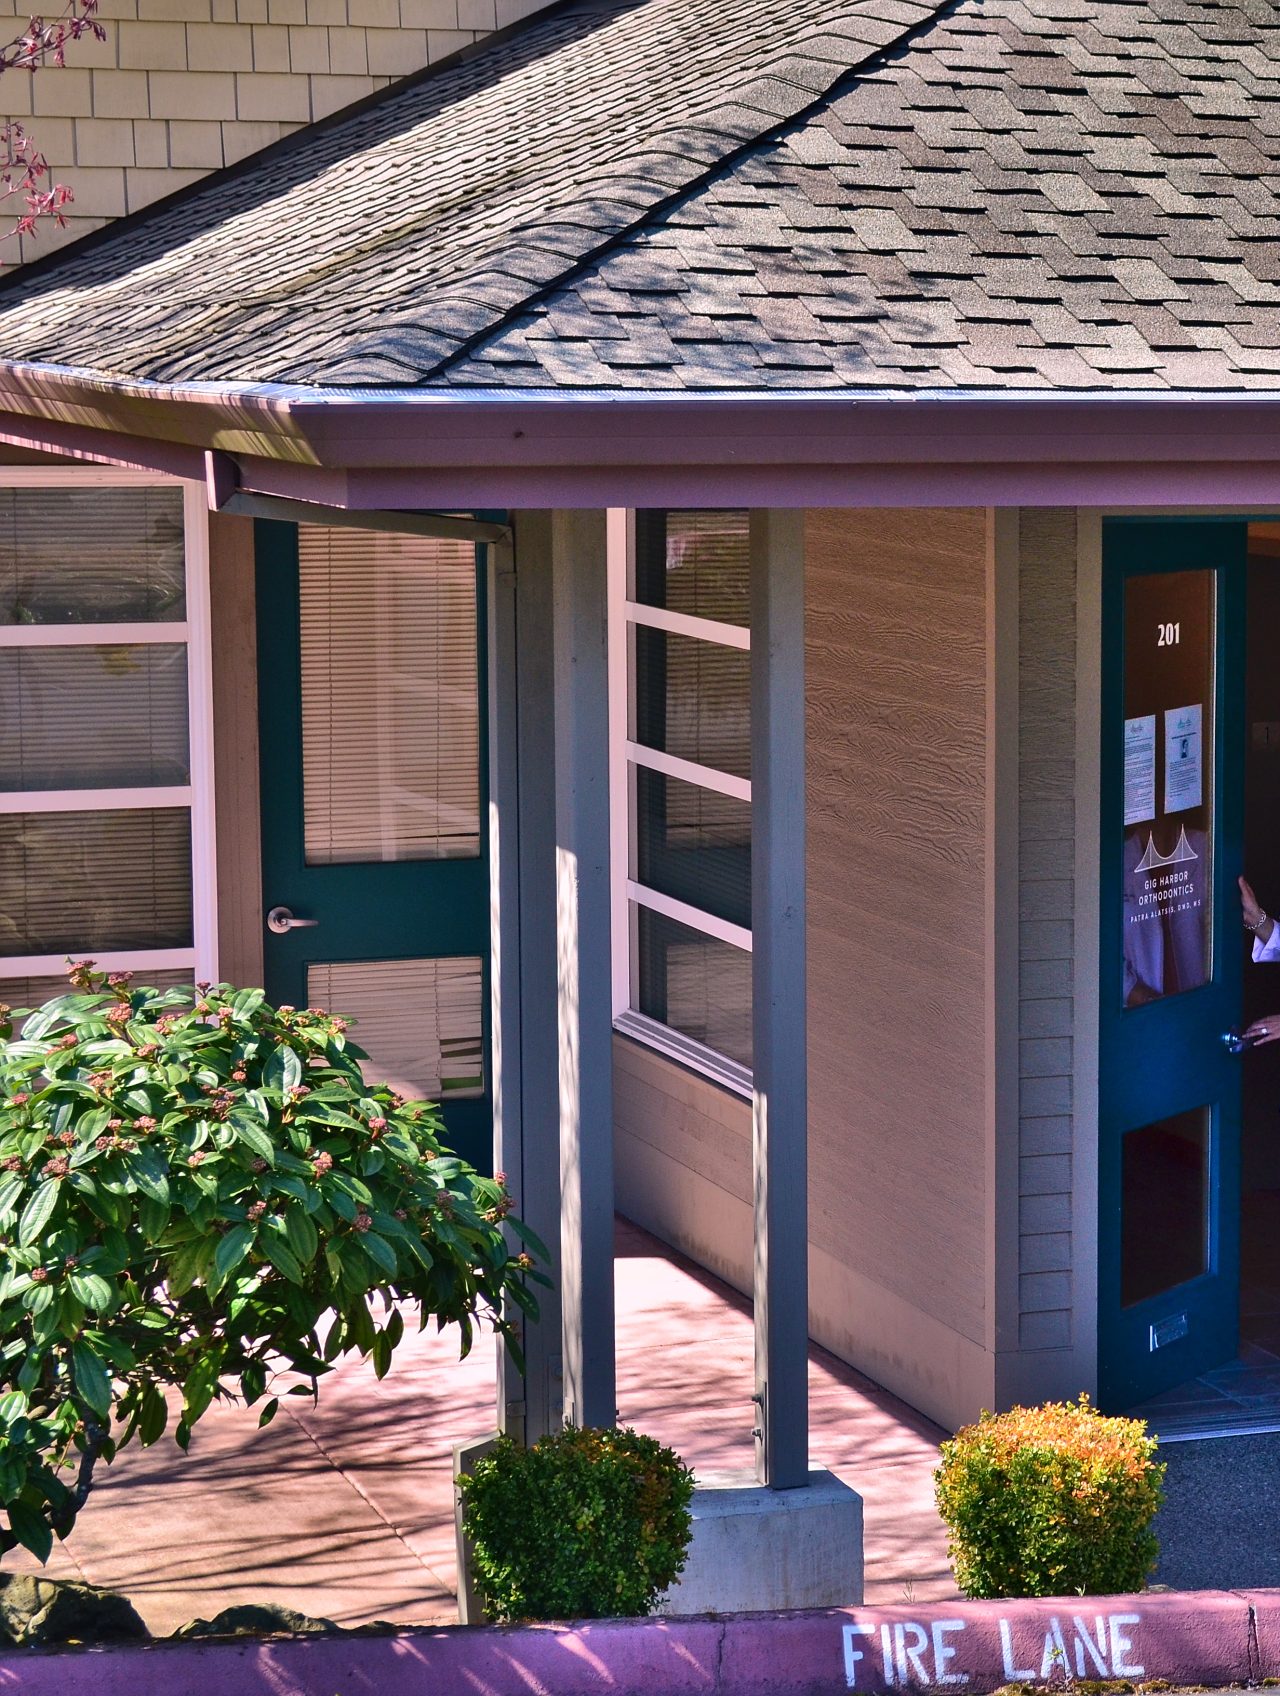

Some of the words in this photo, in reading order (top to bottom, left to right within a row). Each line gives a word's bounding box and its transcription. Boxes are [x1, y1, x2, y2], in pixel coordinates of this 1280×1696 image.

[1157, 622, 1180, 646] 201
[1144, 878, 1157, 890] GIG
[1159, 871, 1188, 887] HARBOR
[1138, 883, 1194, 906] ORTHODONTICS
[1130, 913, 1149, 923] PATRA
[842, 1619, 969, 1687] FIRE
[1000, 1613, 1145, 1682] LANE
